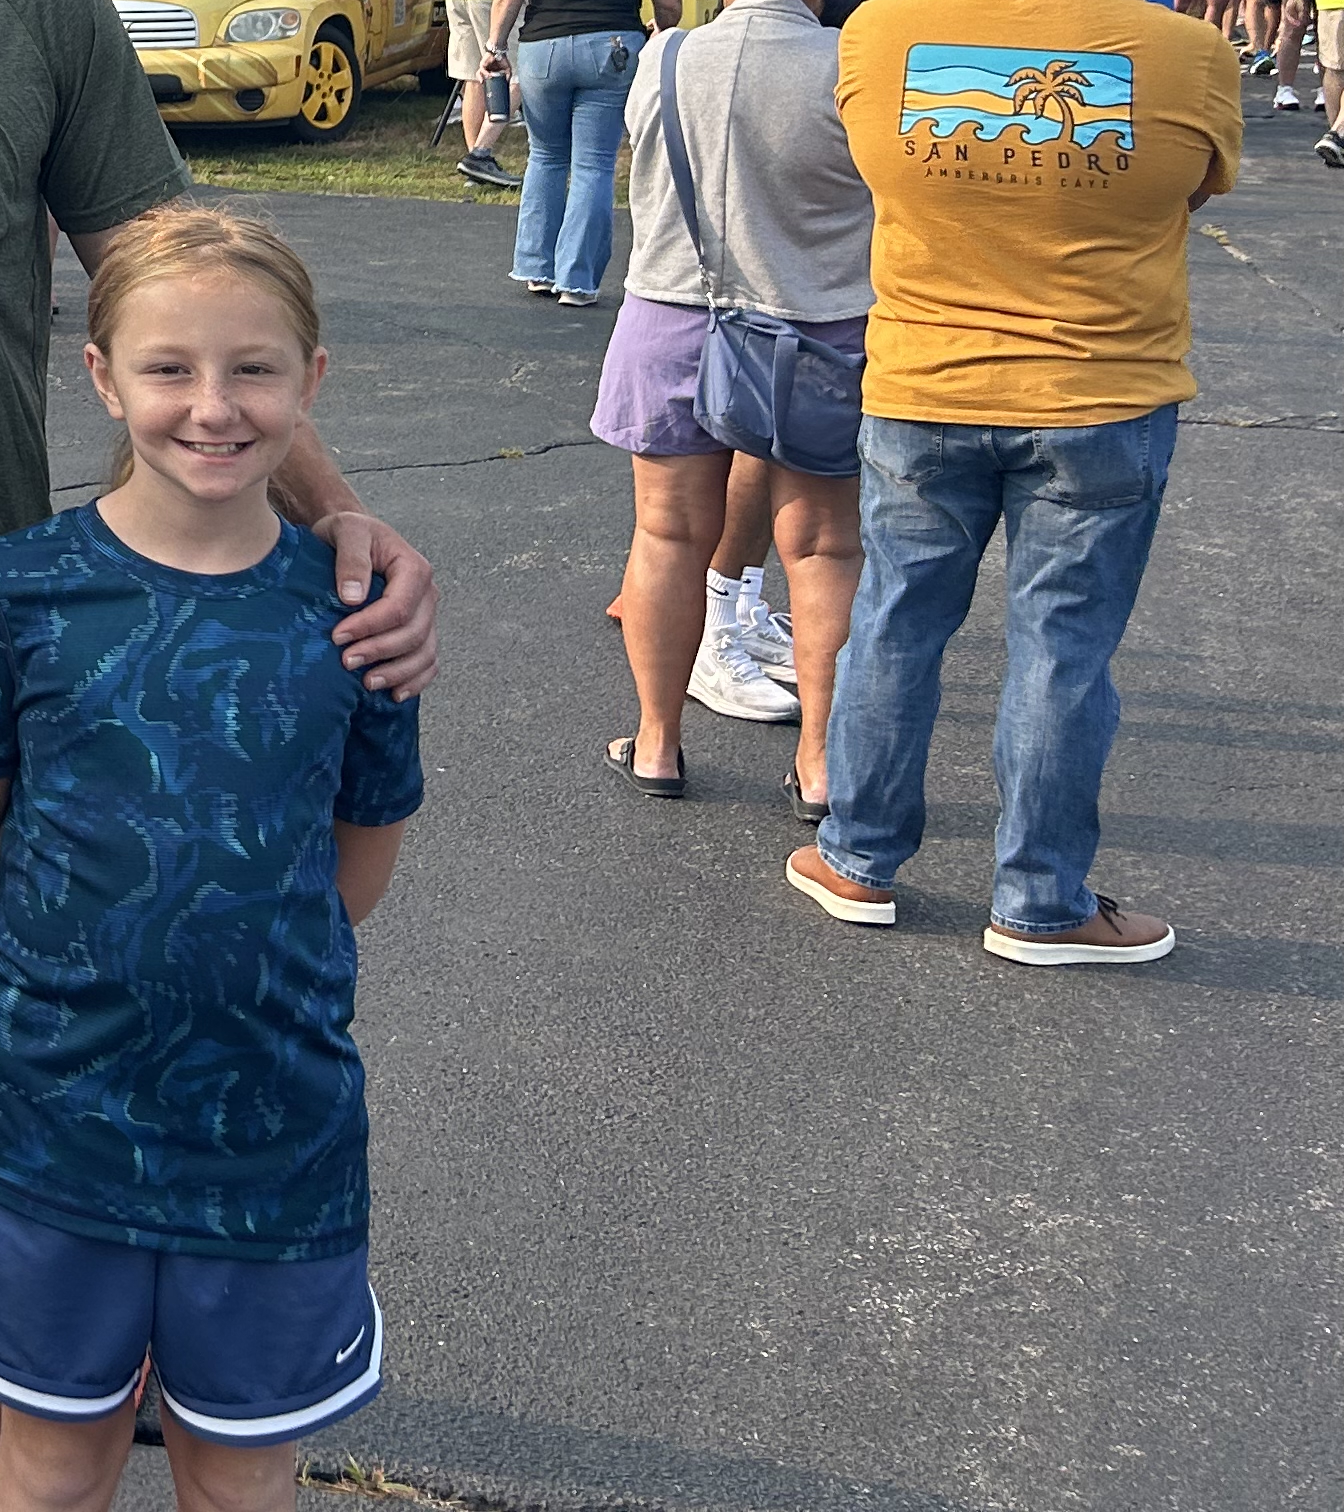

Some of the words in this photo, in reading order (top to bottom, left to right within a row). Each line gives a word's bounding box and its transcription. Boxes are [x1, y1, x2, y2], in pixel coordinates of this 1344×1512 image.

[904, 139, 969, 164] SAN
[1002, 146, 1130, 176] PEDRO
[924, 166, 1043, 186] AMBERGRIS
[1060, 176, 1110, 189] CAYE
